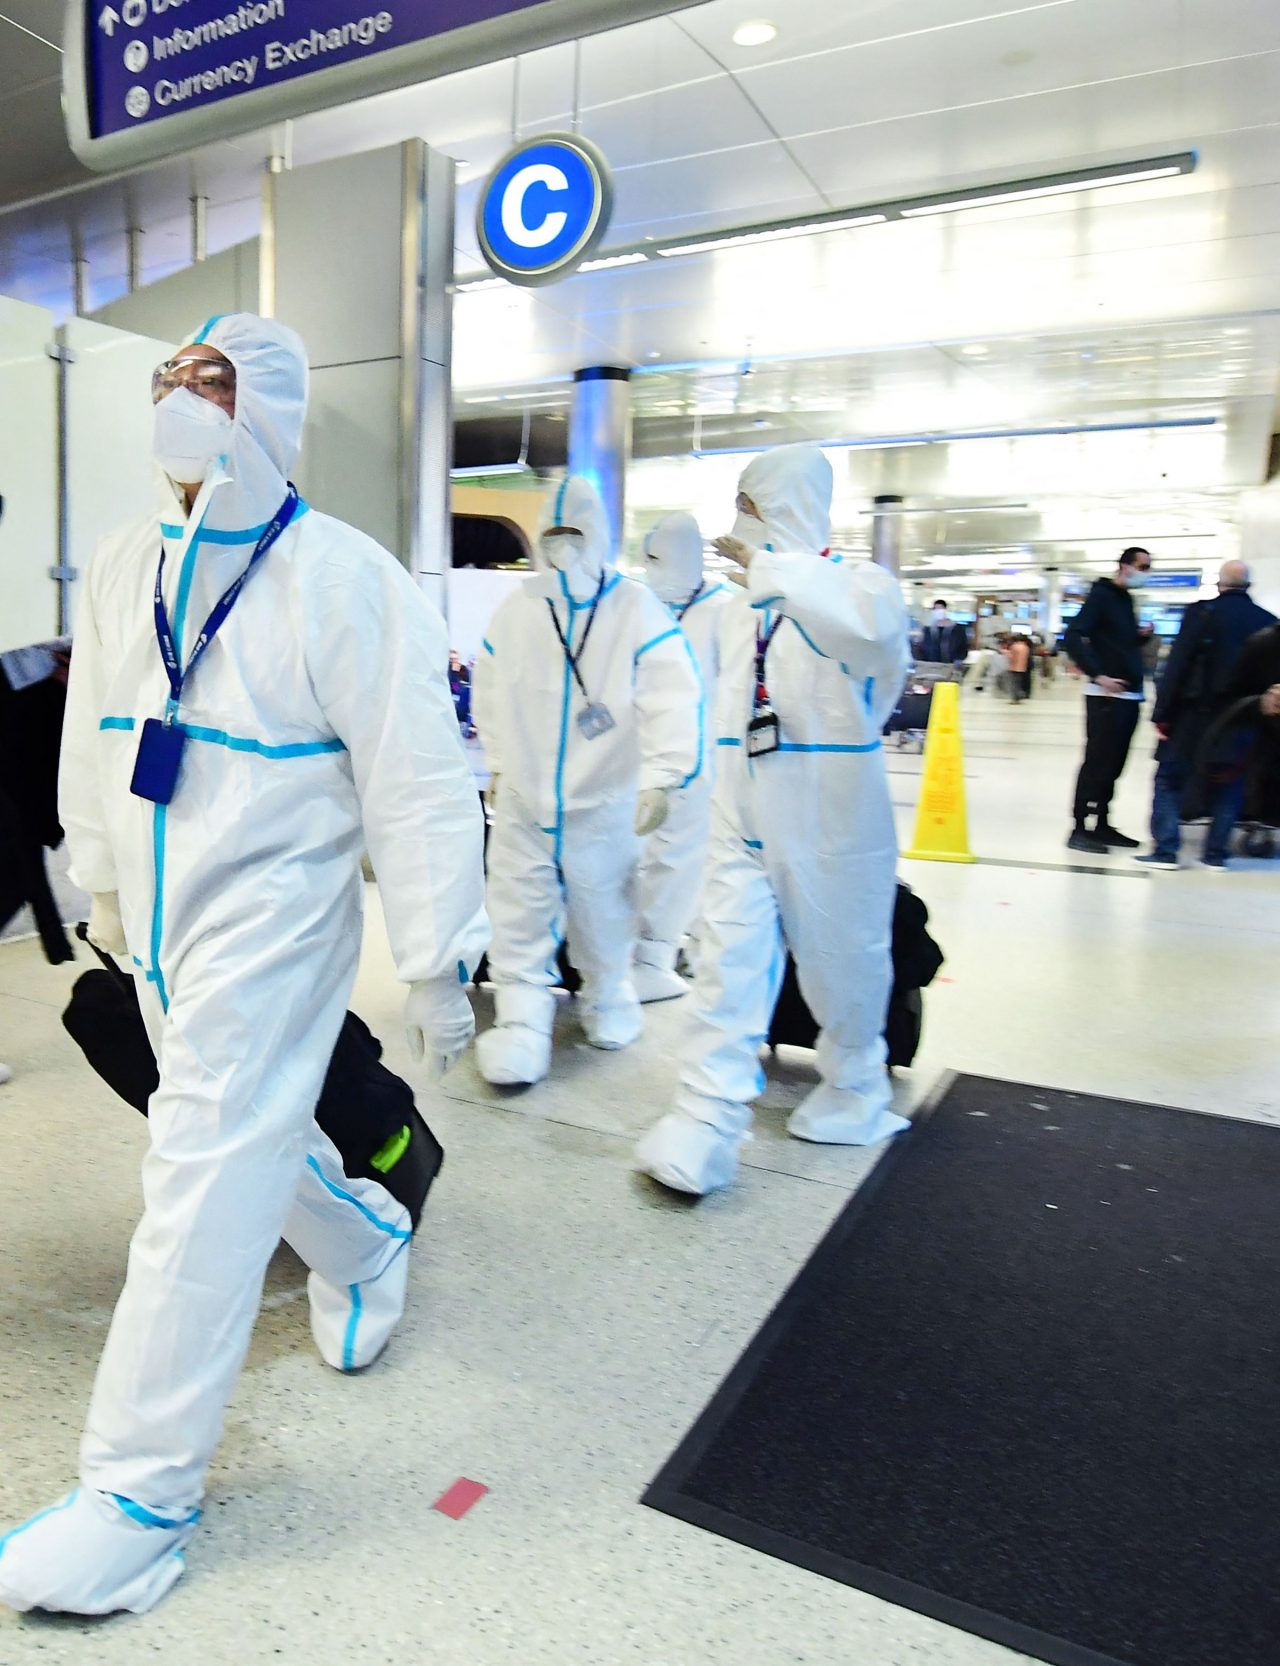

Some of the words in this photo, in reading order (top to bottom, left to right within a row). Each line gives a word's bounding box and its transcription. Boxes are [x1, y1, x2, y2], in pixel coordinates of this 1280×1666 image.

[152, 0, 286, 61] Information
[154, 55, 258, 107] Currency
[264, 10, 393, 71] Exchange
[501, 163, 569, 248] C
